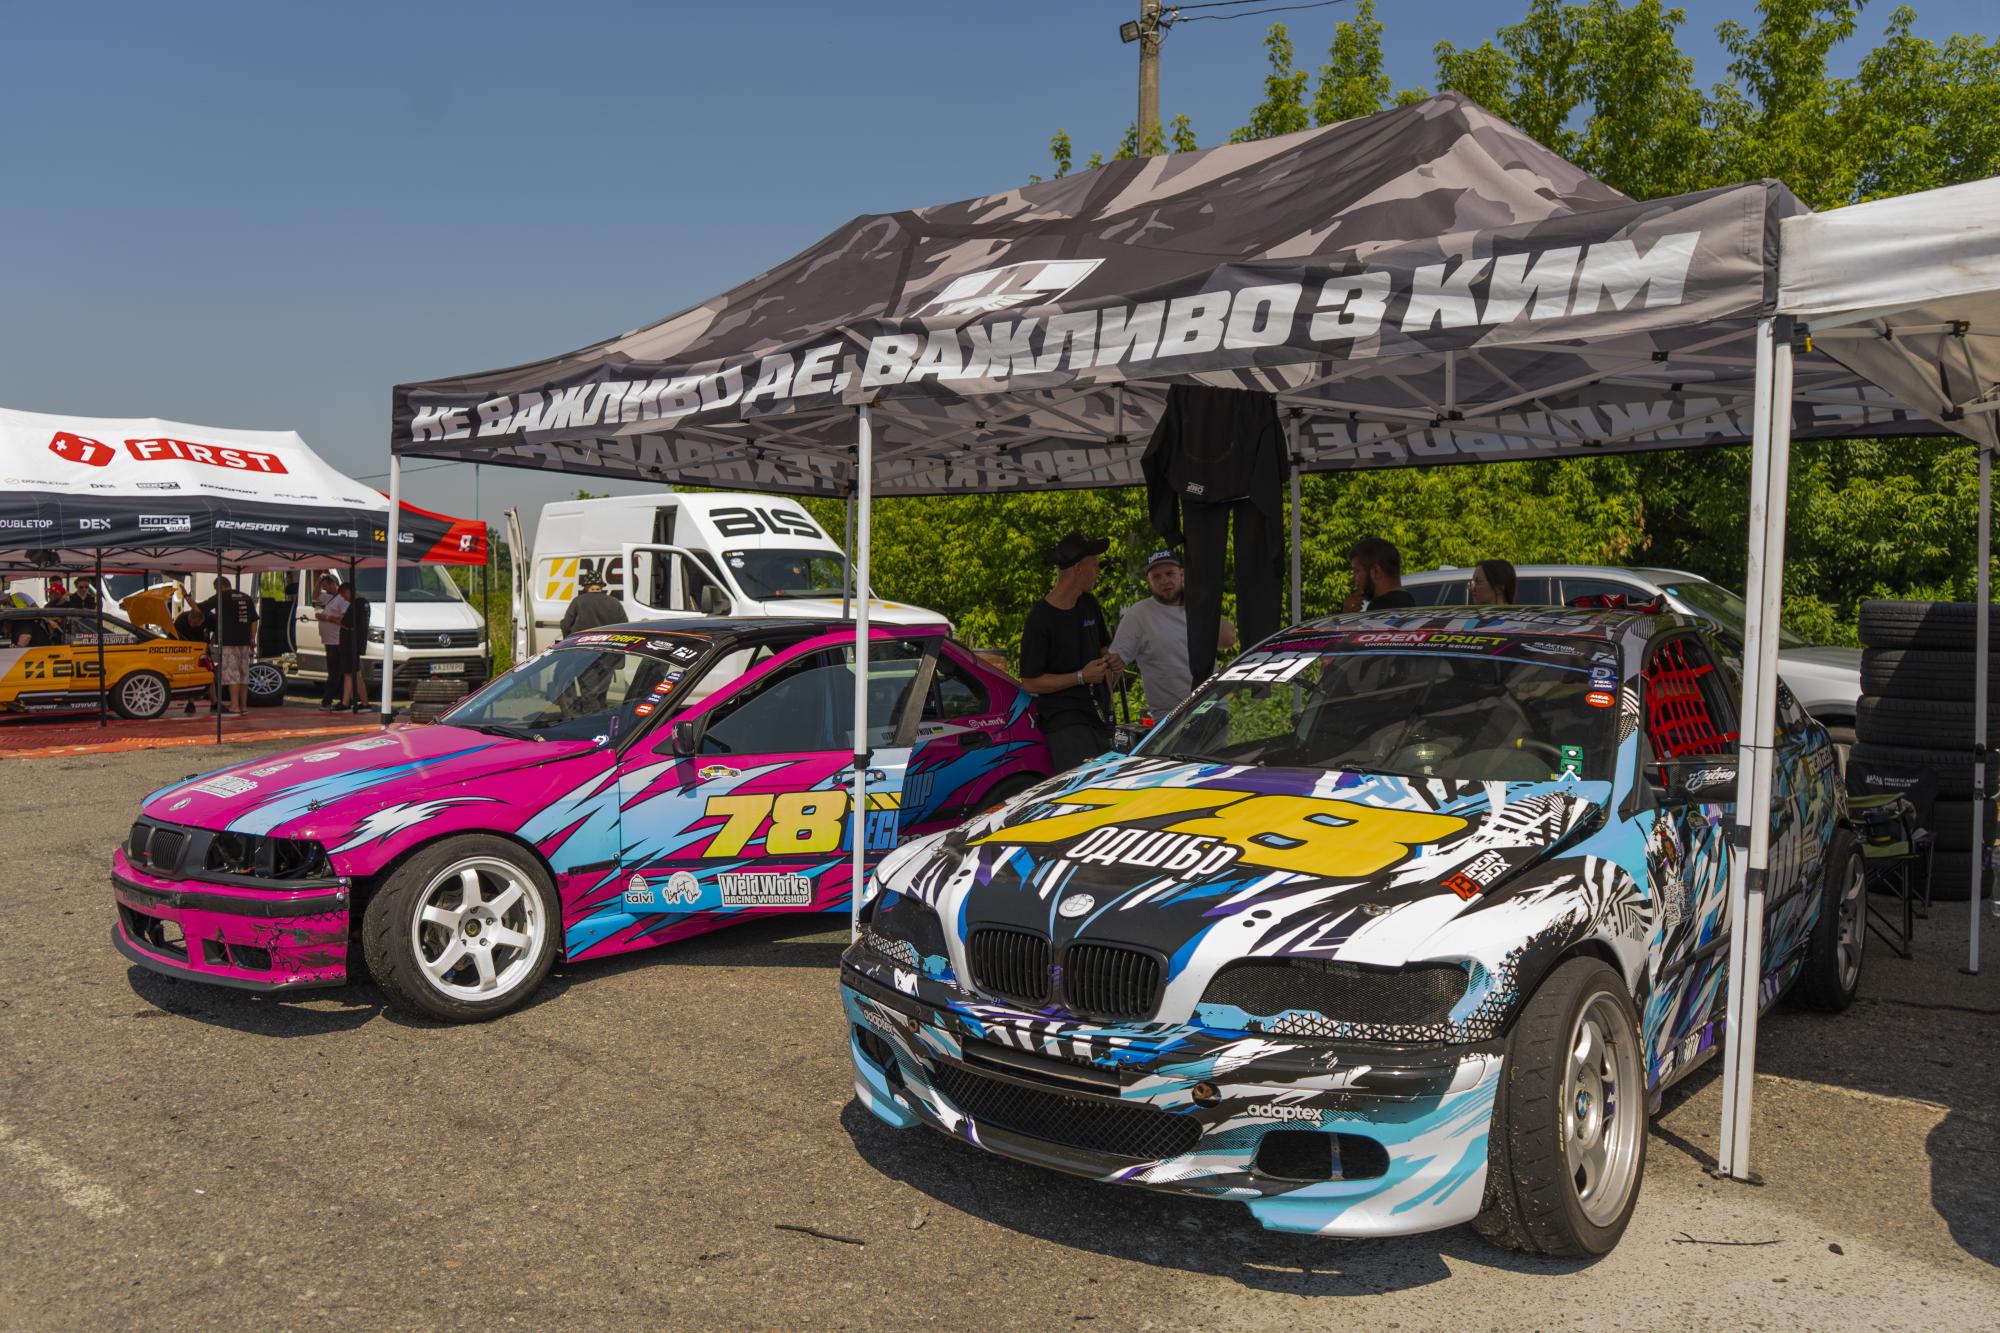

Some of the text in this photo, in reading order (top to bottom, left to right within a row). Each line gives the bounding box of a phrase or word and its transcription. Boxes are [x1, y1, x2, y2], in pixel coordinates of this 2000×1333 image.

[410, 404, 472, 442] НЕ
[476, 364, 744, 436] ВАЖЛИВО
[861, 281, 1303, 389] ВАЖЛИВО
[1400, 230, 1702, 333] КИМ
[134, 440, 273, 472] FIRST
[79, 518, 112, 530] DEX
[141, 516, 190, 526] BOOST
[708, 507, 823, 539] BLS
[306, 526, 359, 539] ATLAS
[1357, 632, 1508, 647] OPEN DRIFT
[1447, 643, 1484, 651] SERIES
[52, 659, 107, 679] BLS
[1215, 651, 1322, 682] 221
[702, 791, 849, 859] 78
[965, 786, 1471, 878] 78
[720, 874, 808, 896] Weld.Works
[625, 893, 654, 903] talvi
[724, 894, 809, 904] RACING WORKSHOP
[863, 1008, 896, 1037] adaptex
[1247, 1103, 1324, 1123] adaptex
